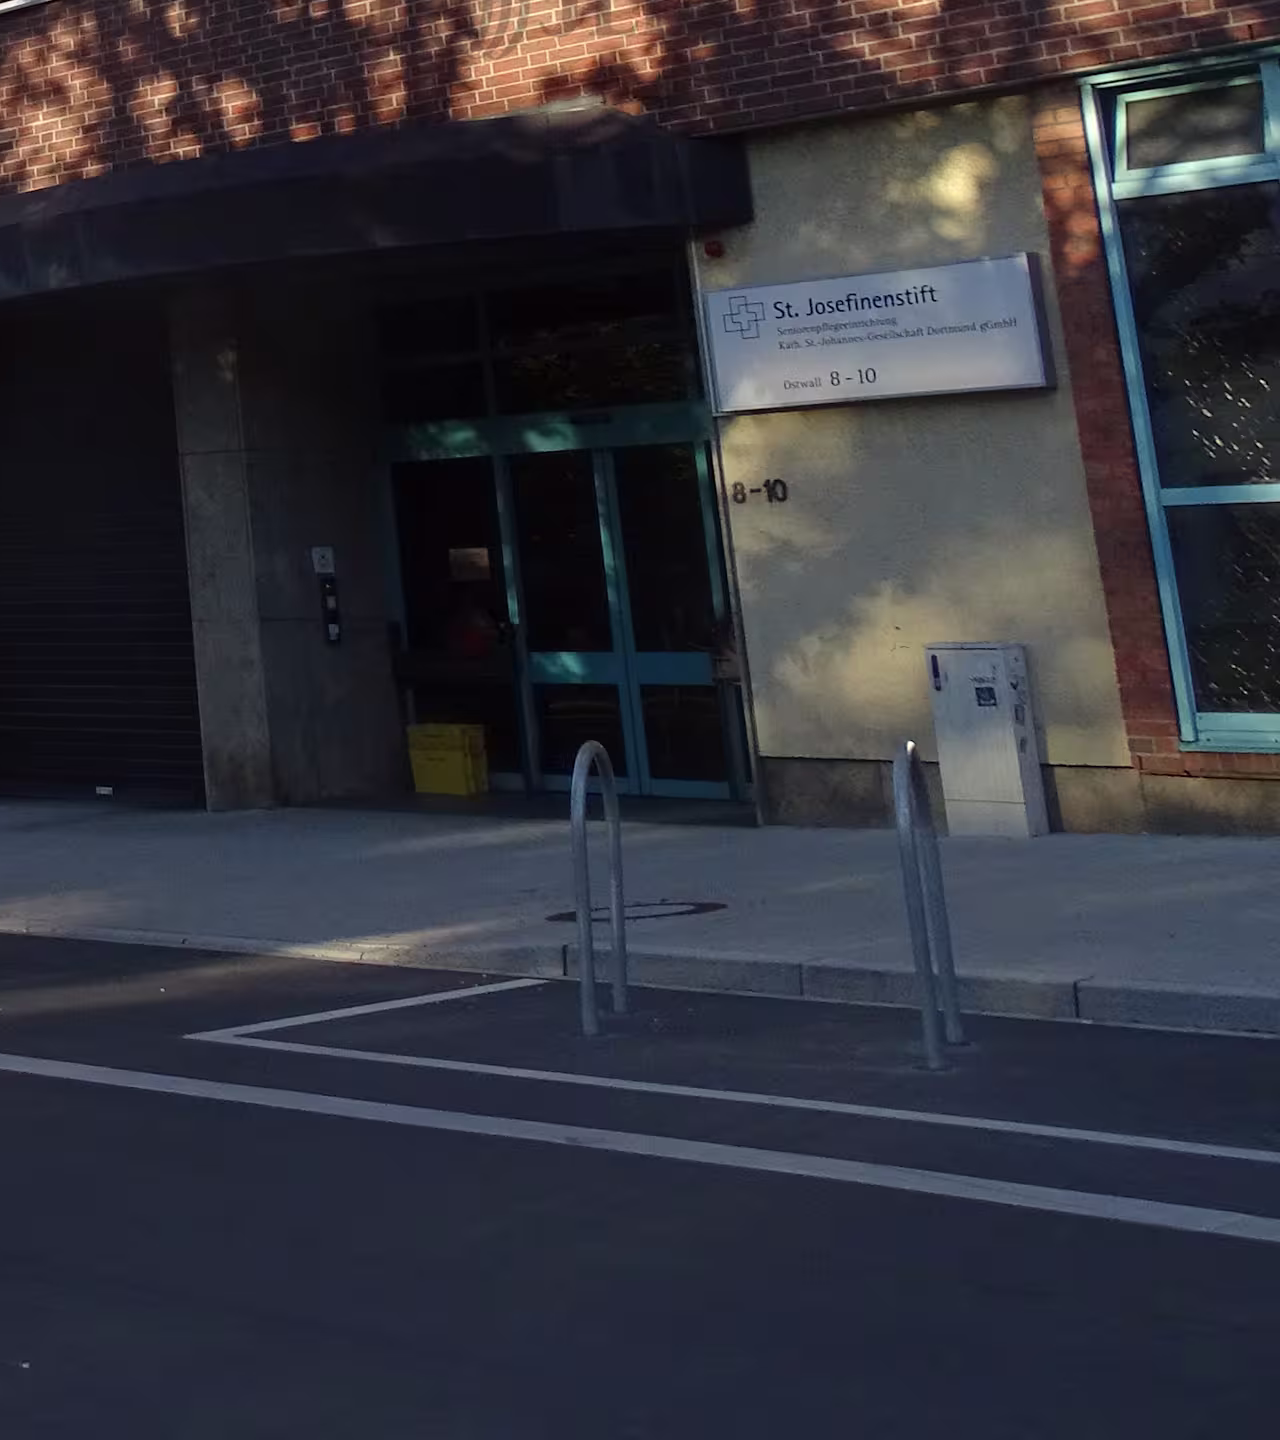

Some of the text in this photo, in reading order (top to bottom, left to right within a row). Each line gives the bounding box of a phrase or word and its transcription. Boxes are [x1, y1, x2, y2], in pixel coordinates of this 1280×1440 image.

[773, 284, 938, 319] St. Josefinenstift
[927, 321, 976, 336] Dortmund
[979, 317, 1017, 333] gGmbH
[783, 376, 822, 391] Ostwall
